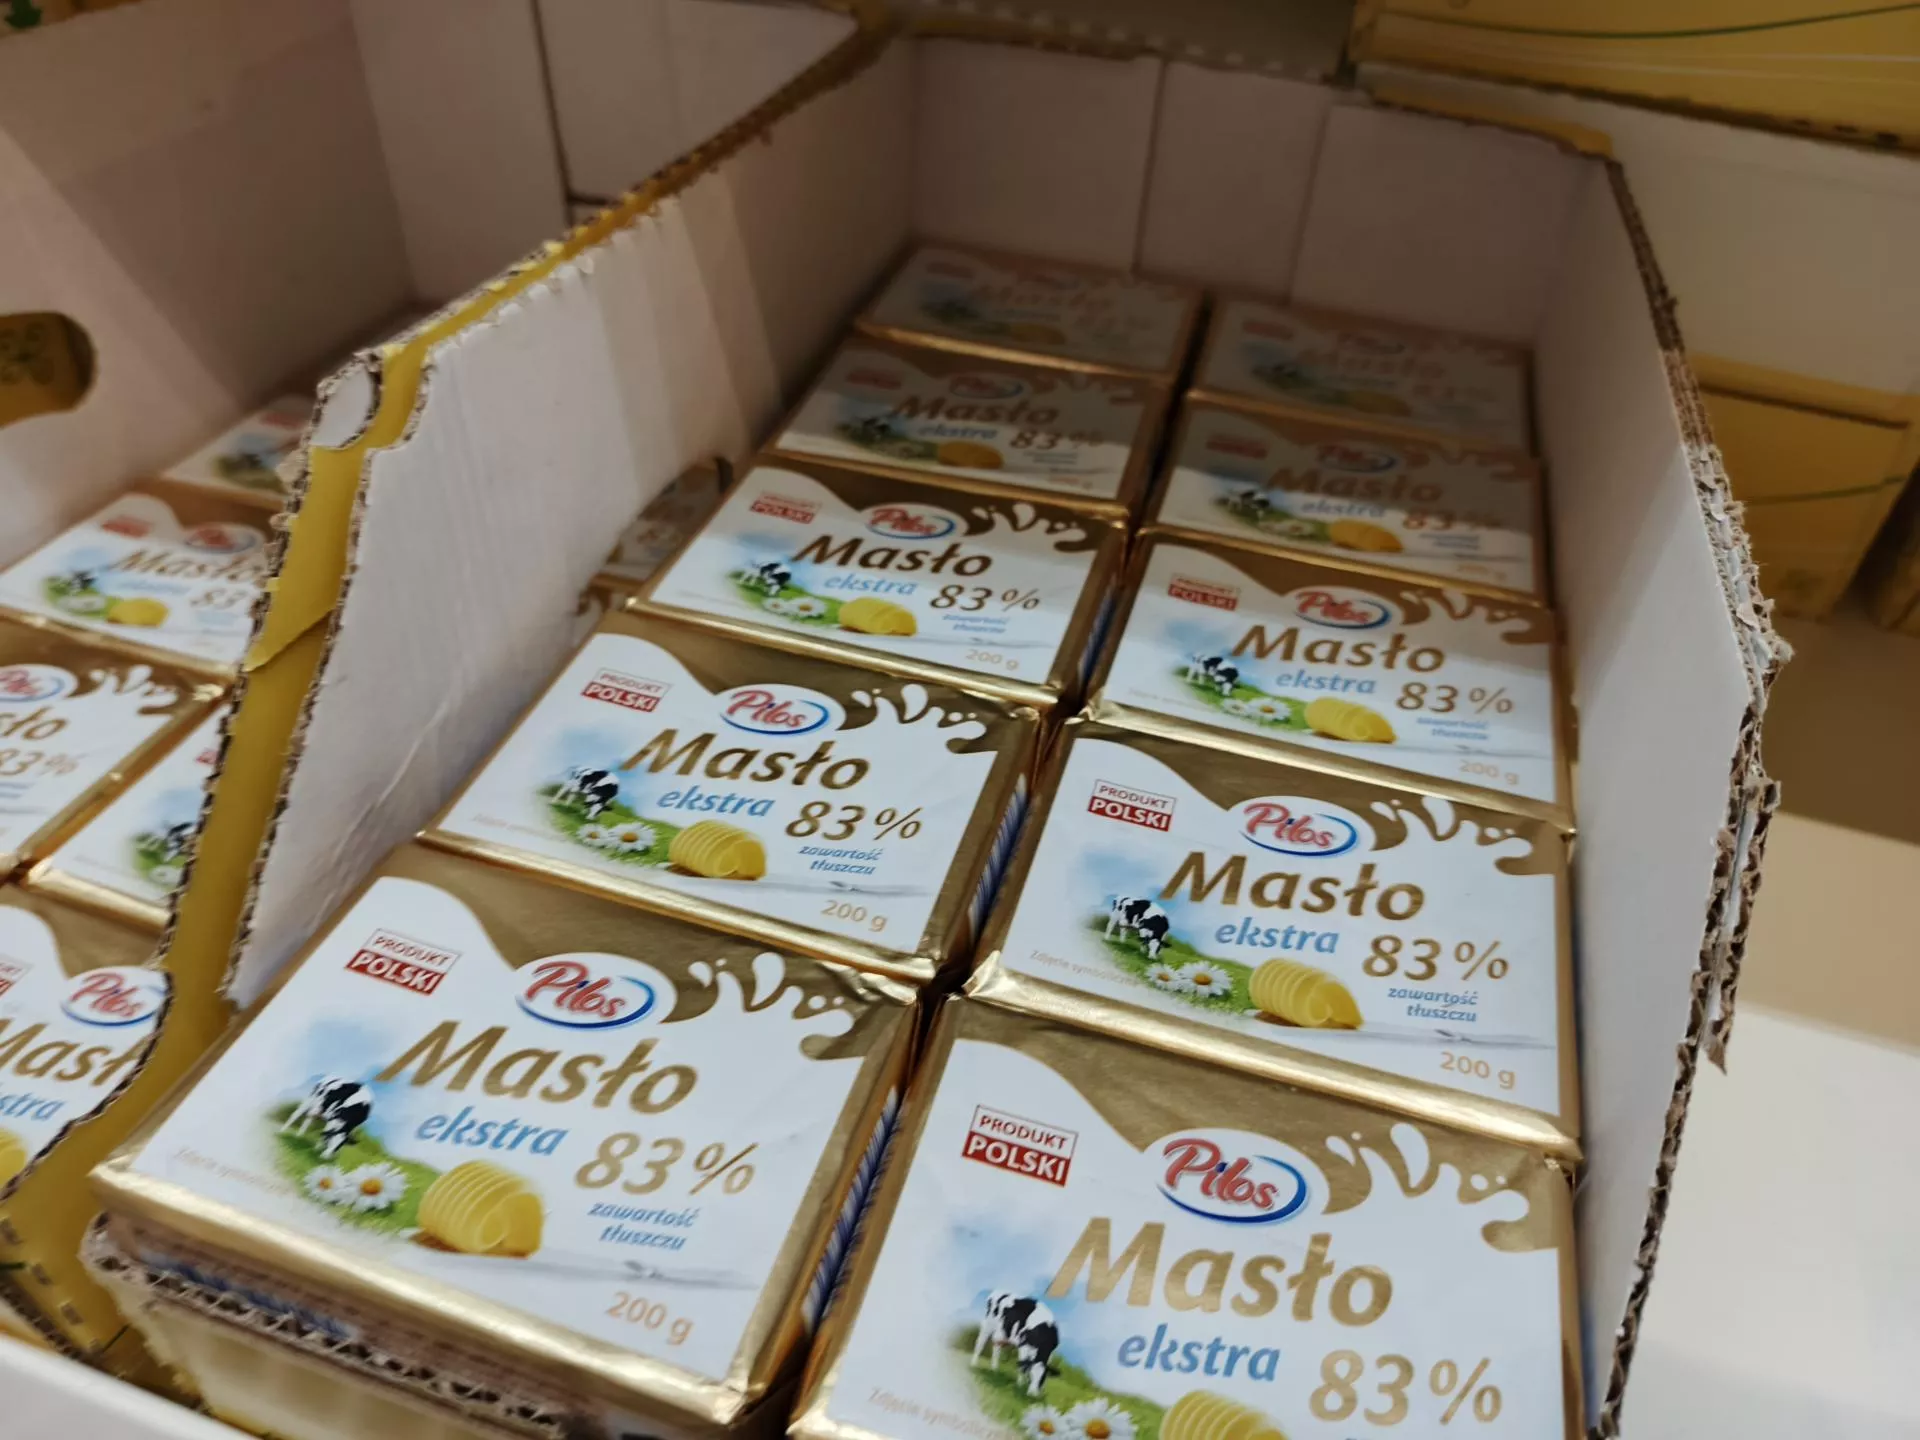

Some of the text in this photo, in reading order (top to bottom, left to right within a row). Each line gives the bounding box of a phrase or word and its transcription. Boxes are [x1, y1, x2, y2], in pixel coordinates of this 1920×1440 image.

[791, 534, 993, 576] Masło
[824, 573, 919, 595] ekstra
[1231, 625, 1445, 672] Masło
[585, 683, 656, 711] POLSKI
[1276, 670, 1377, 694] ekstra
[727, 689, 808, 728] Pilos
[618, 728, 870, 789] Masło
[656, 785, 776, 817] ekstra
[1091, 797, 1169, 829] POLSKI
[1098, 785, 1169, 810] PRODUKT
[1243, 802, 1336, 848] Pilos
[798, 845, 884, 861] zawartość
[809, 859, 876, 875] tłuszczu
[1157, 851, 1425, 921] Masło
[820, 900, 888, 932] 200 g
[1214, 916, 1340, 953] ekstra
[374, 935, 449, 967] PRODUKT
[351, 951, 439, 993] POLSKI
[524, 960, 627, 1018] Pilos
[1387, 987, 1479, 1006] zawartość
[1406, 1003, 1477, 1022] tłuszczu
[373, 1020, 698, 1115] Masło
[1440, 1051, 1517, 1090] 200 g
[416, 1105, 569, 1155] ekstra
[979, 1114, 1069, 1150] PRODUKT
[966, 1135, 1067, 1183] POLSKI
[1162, 1137, 1279, 1210] Pilos
[587, 1202, 702, 1228] zawartość
[598, 1224, 687, 1250] tłuszczu
[1046, 1216, 1394, 1327] Masło
[605, 1290, 694, 1346] 200 g
[1117, 1322, 1281, 1382] ekstra
